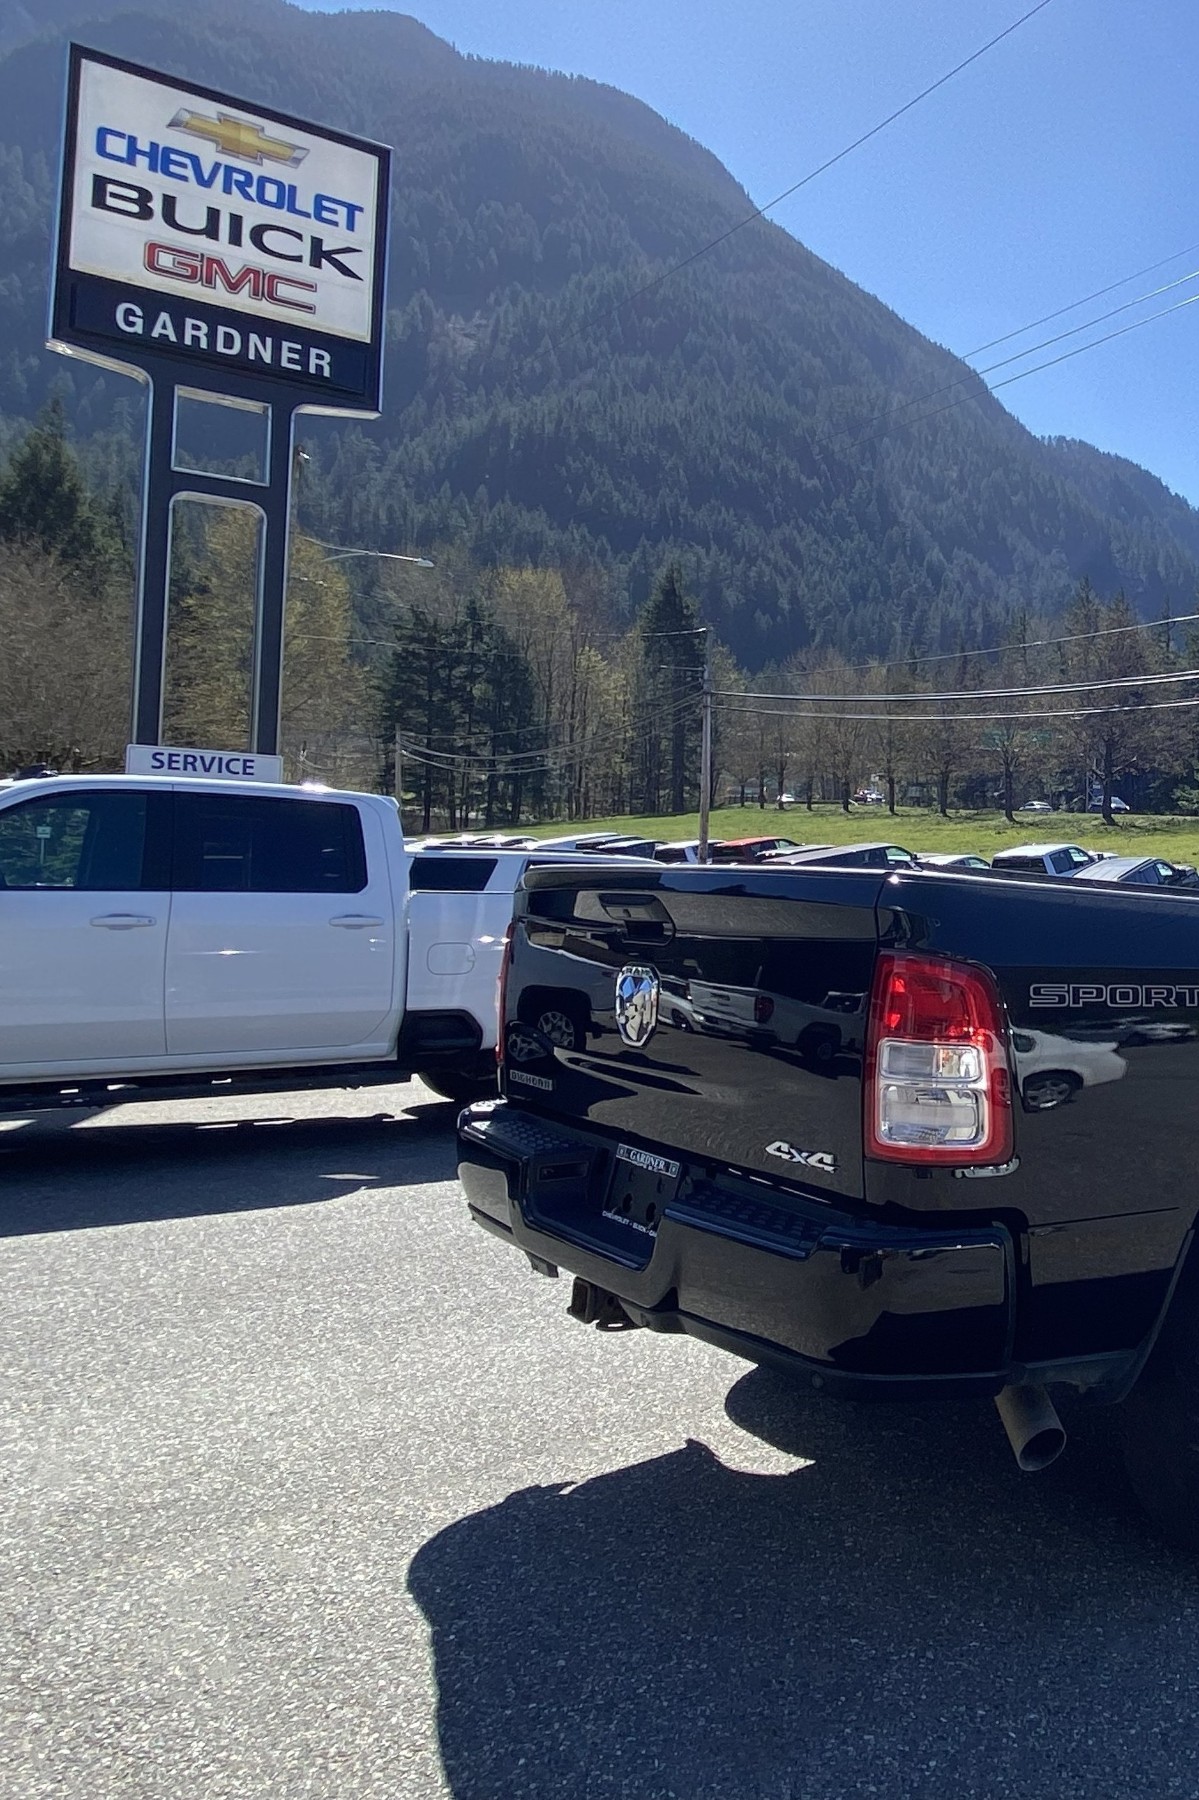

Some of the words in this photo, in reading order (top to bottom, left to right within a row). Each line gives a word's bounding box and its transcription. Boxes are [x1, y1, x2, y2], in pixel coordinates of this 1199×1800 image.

[96, 127, 364, 232] CHEVROLET
[91, 174, 364, 281] BUICK
[144, 240, 317, 314] GMC
[115, 303, 332, 378] GARDNER
[151, 752, 255, 775] SERVICE
[630, 1150, 665, 1169] GARDNER
